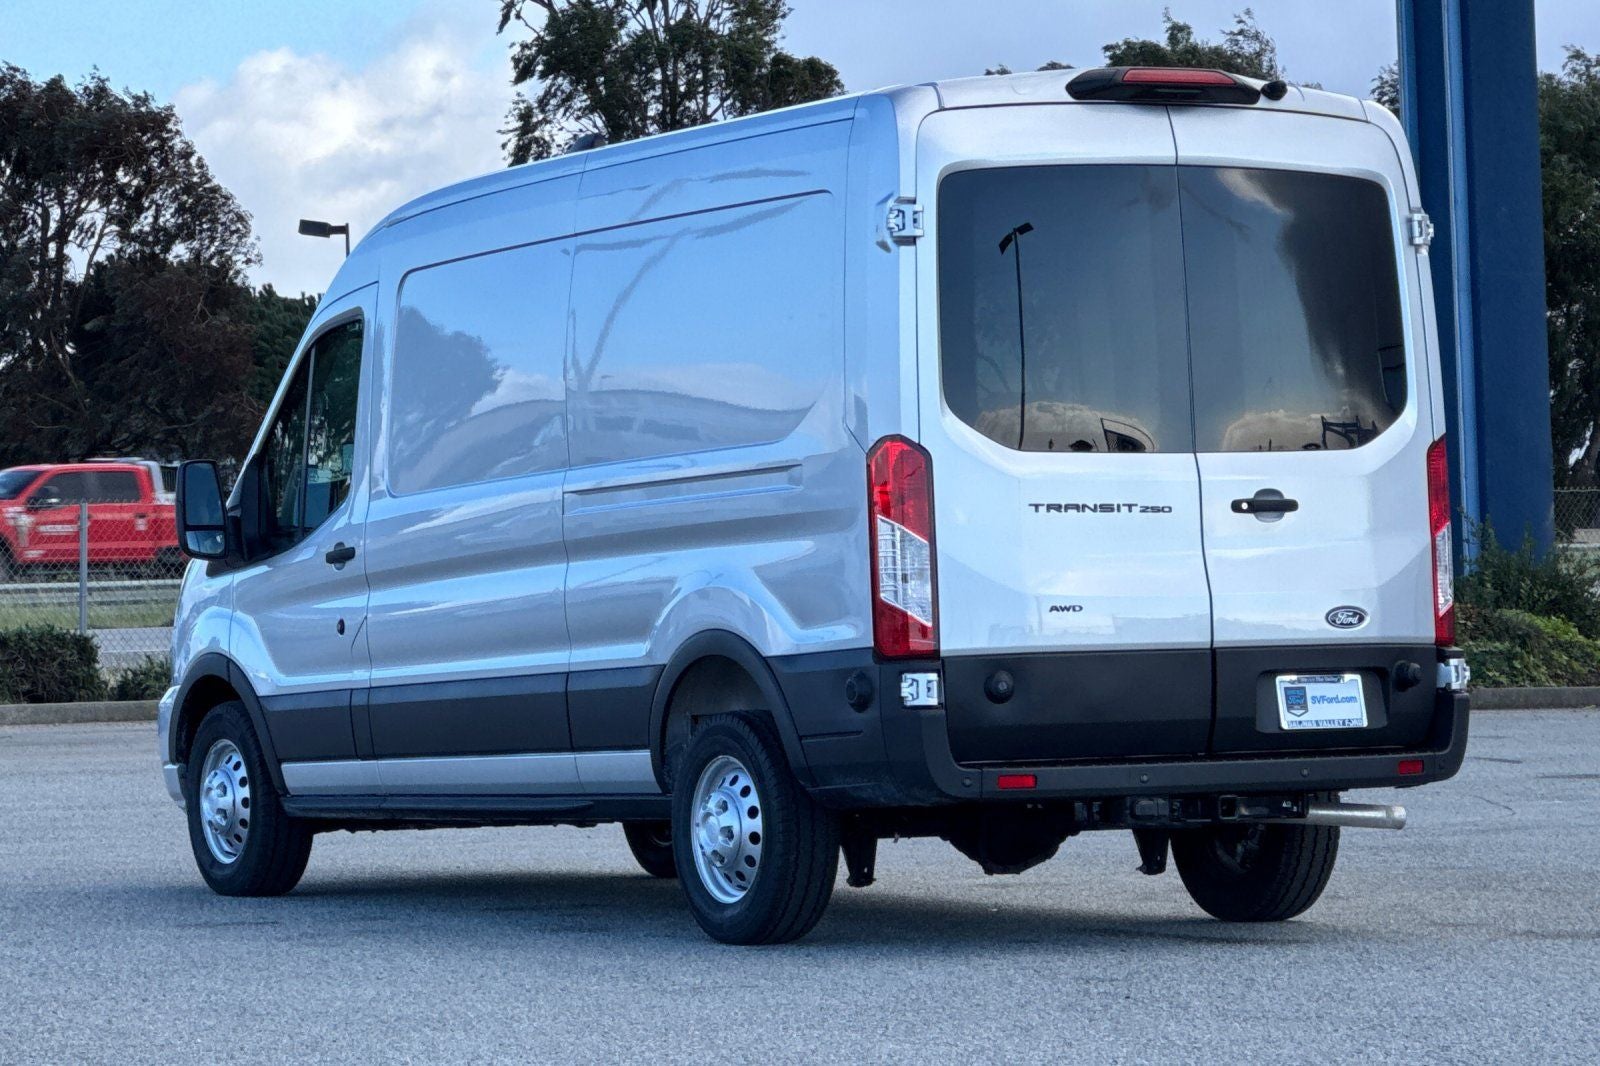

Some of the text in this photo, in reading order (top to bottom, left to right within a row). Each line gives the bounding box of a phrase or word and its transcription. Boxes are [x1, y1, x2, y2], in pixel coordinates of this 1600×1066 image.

[1028, 503, 1172, 513] TRANSIT 250
[1049, 604, 1083, 613] AWD
[1335, 611, 1360, 625] Ford
[1310, 694, 1358, 705] SVFord.com
[1318, 719, 1342, 727] VALLEY
